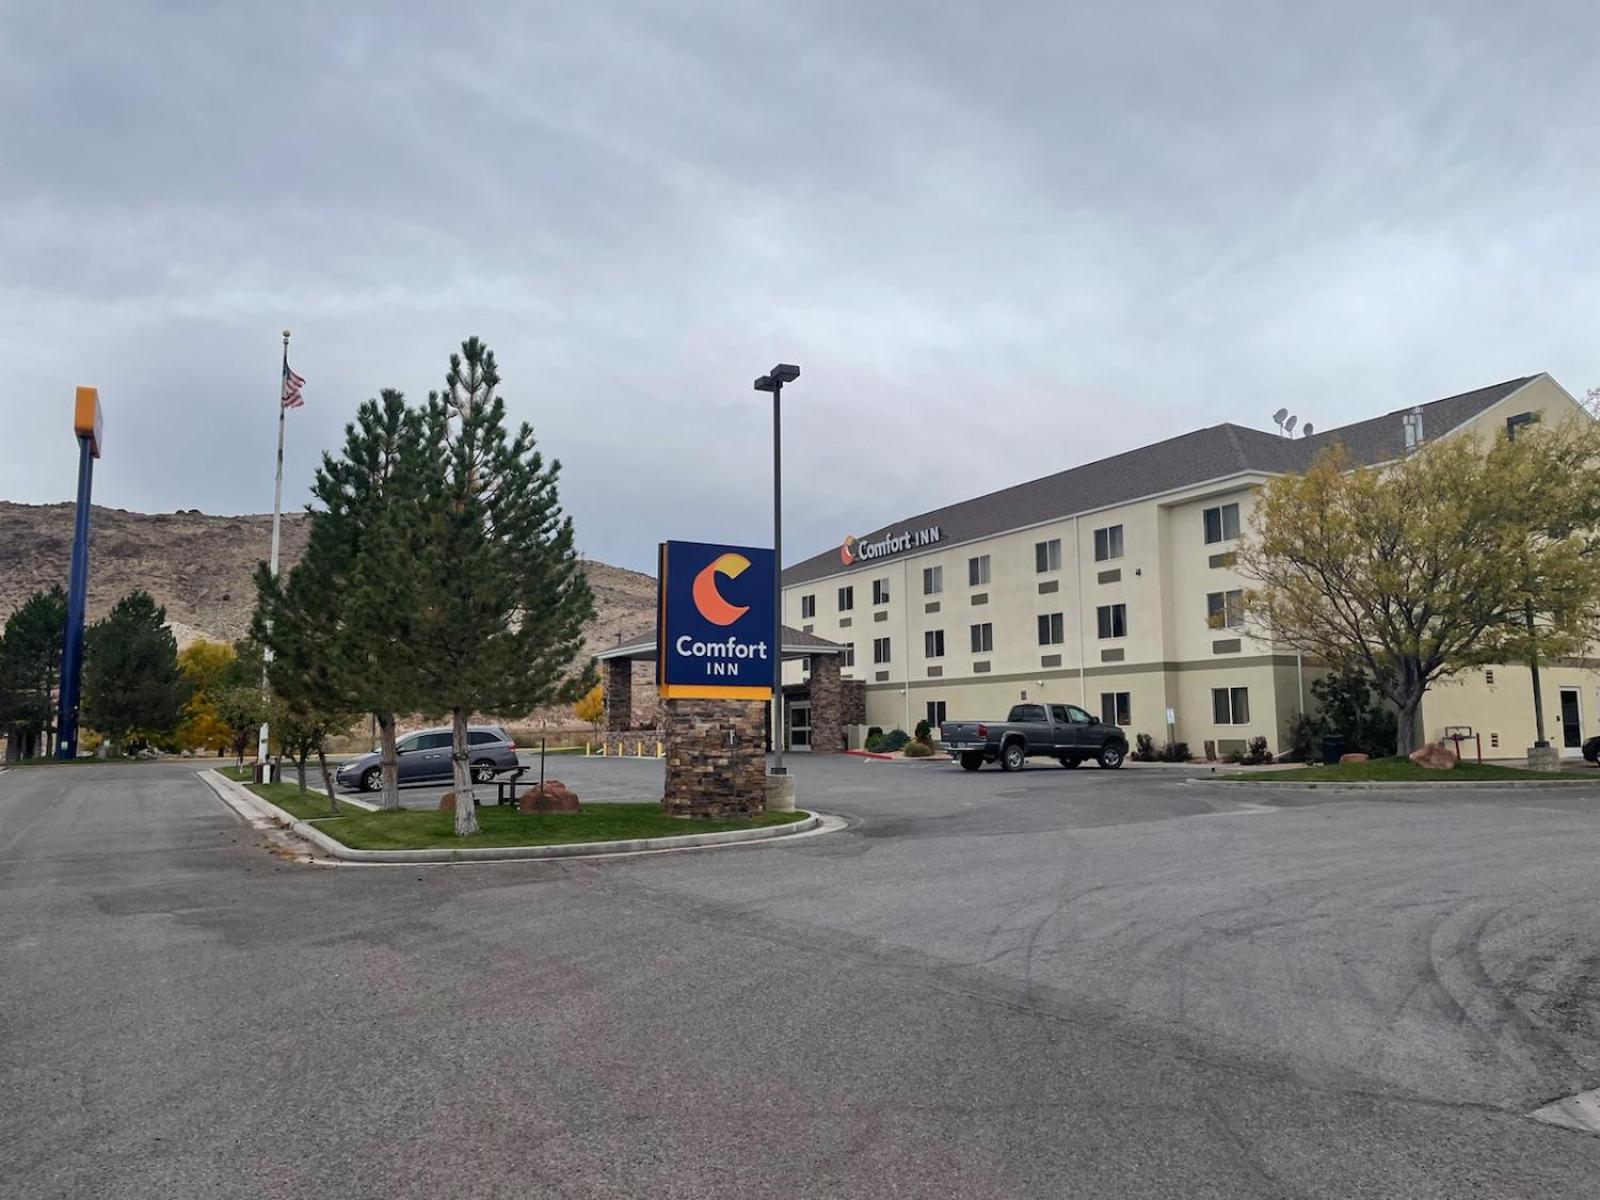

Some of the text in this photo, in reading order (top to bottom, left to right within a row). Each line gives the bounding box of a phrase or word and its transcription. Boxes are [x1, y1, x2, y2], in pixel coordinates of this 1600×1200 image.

[859, 526, 940, 560] Comfort INN
[676, 635, 768, 659] Comfort
[706, 662, 739, 676] INN
